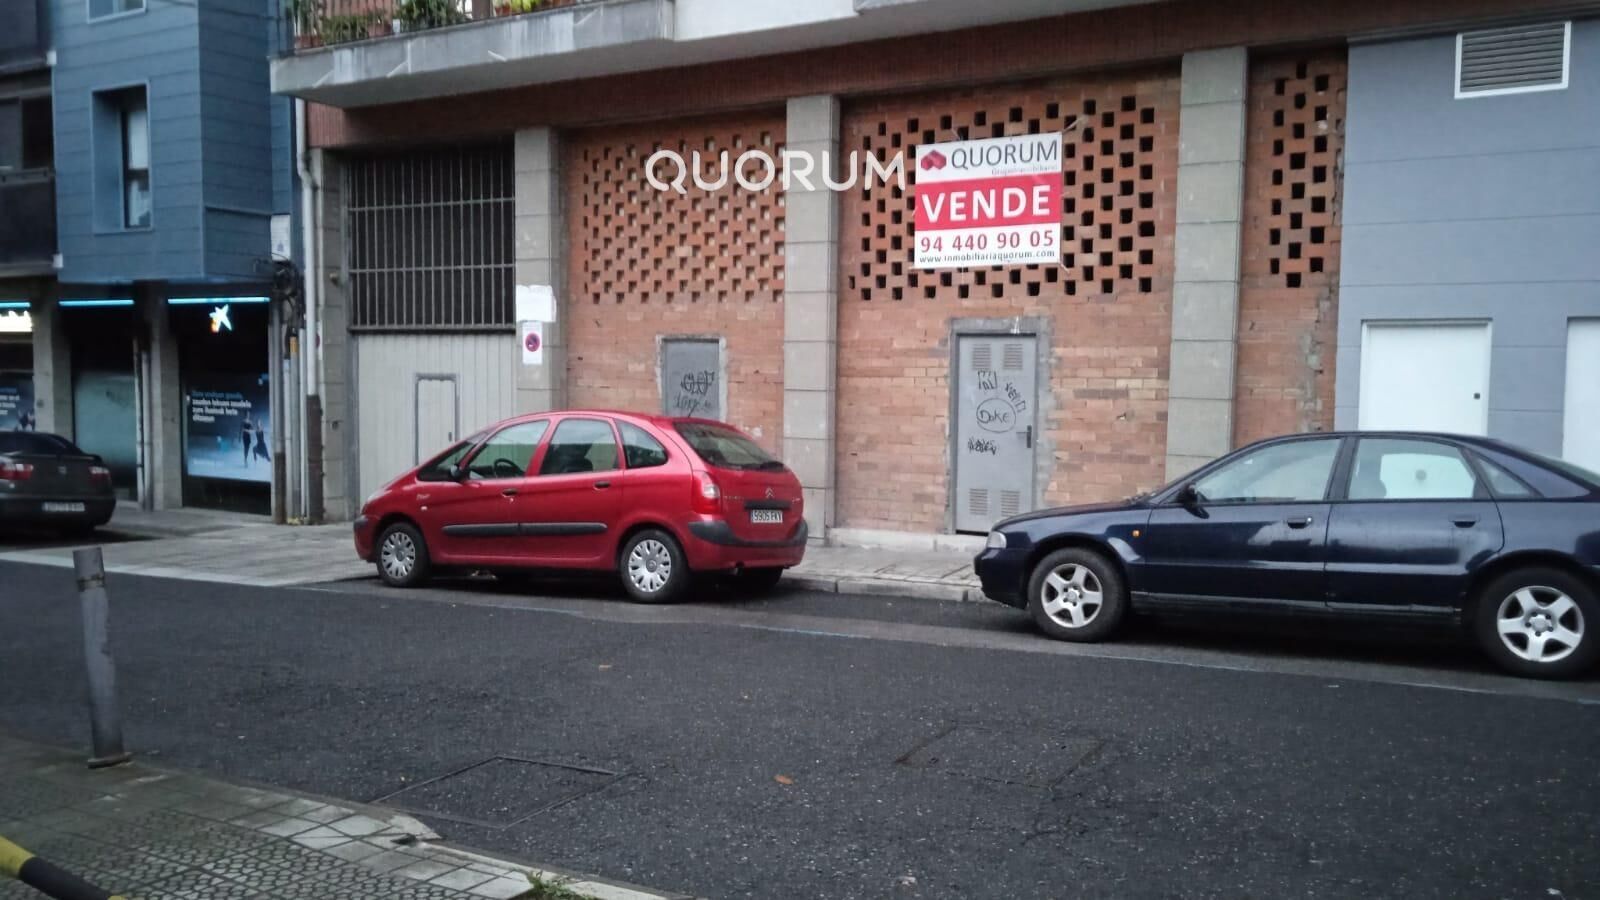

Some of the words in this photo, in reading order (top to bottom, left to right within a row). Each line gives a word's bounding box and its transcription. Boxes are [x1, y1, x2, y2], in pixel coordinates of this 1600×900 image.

[951, 139, 1057, 170] QUORUM
[921, 184, 1051, 223] VENDE
[920, 236, 943, 253] 94
[952, 233, 988, 251] 440
[997, 231, 1020, 249] 90
[1029, 230, 1054, 248] 05
[919, 250, 1055, 264] www.inmobiliariaquorum.com
